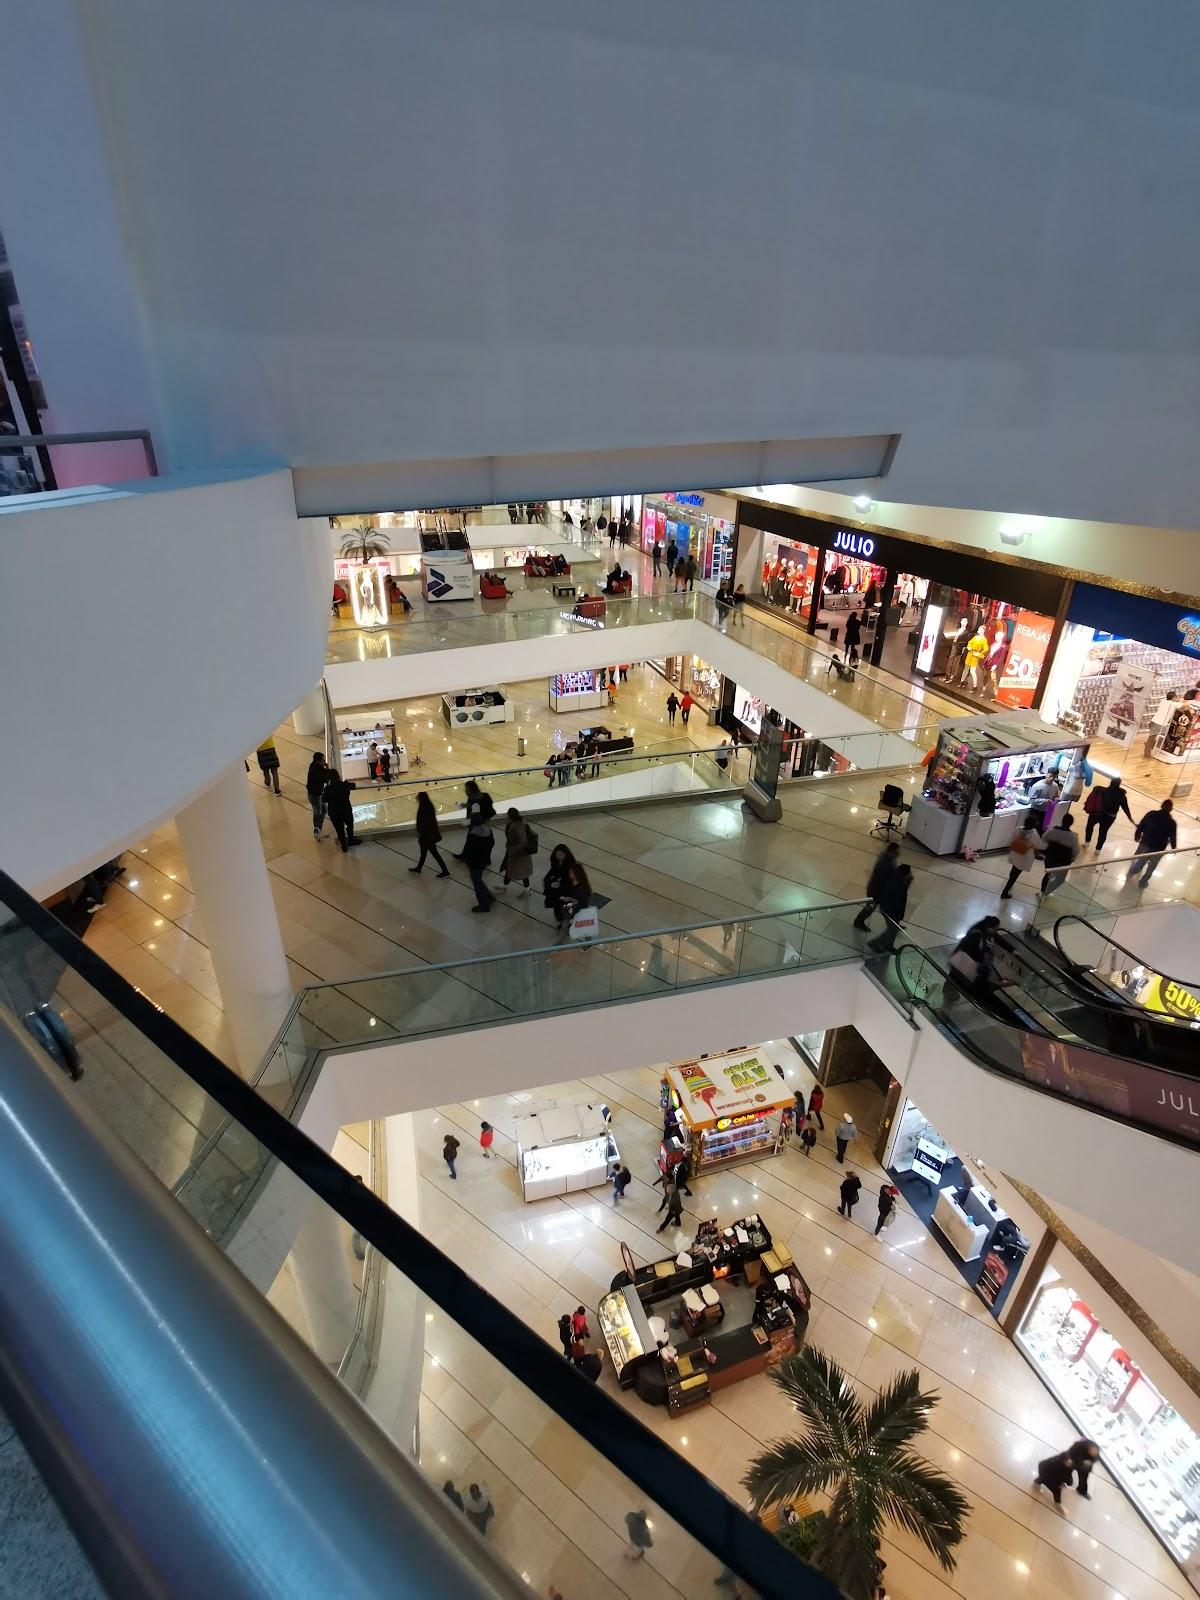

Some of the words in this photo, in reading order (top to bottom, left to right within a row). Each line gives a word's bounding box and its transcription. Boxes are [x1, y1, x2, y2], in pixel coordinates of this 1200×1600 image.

[834, 532, 874, 556] JULIO
[1017, 623, 1051, 643] REBAJAS
[1165, 982, 1200, 1017] 50%
[730, 1071, 757, 1088] TU
